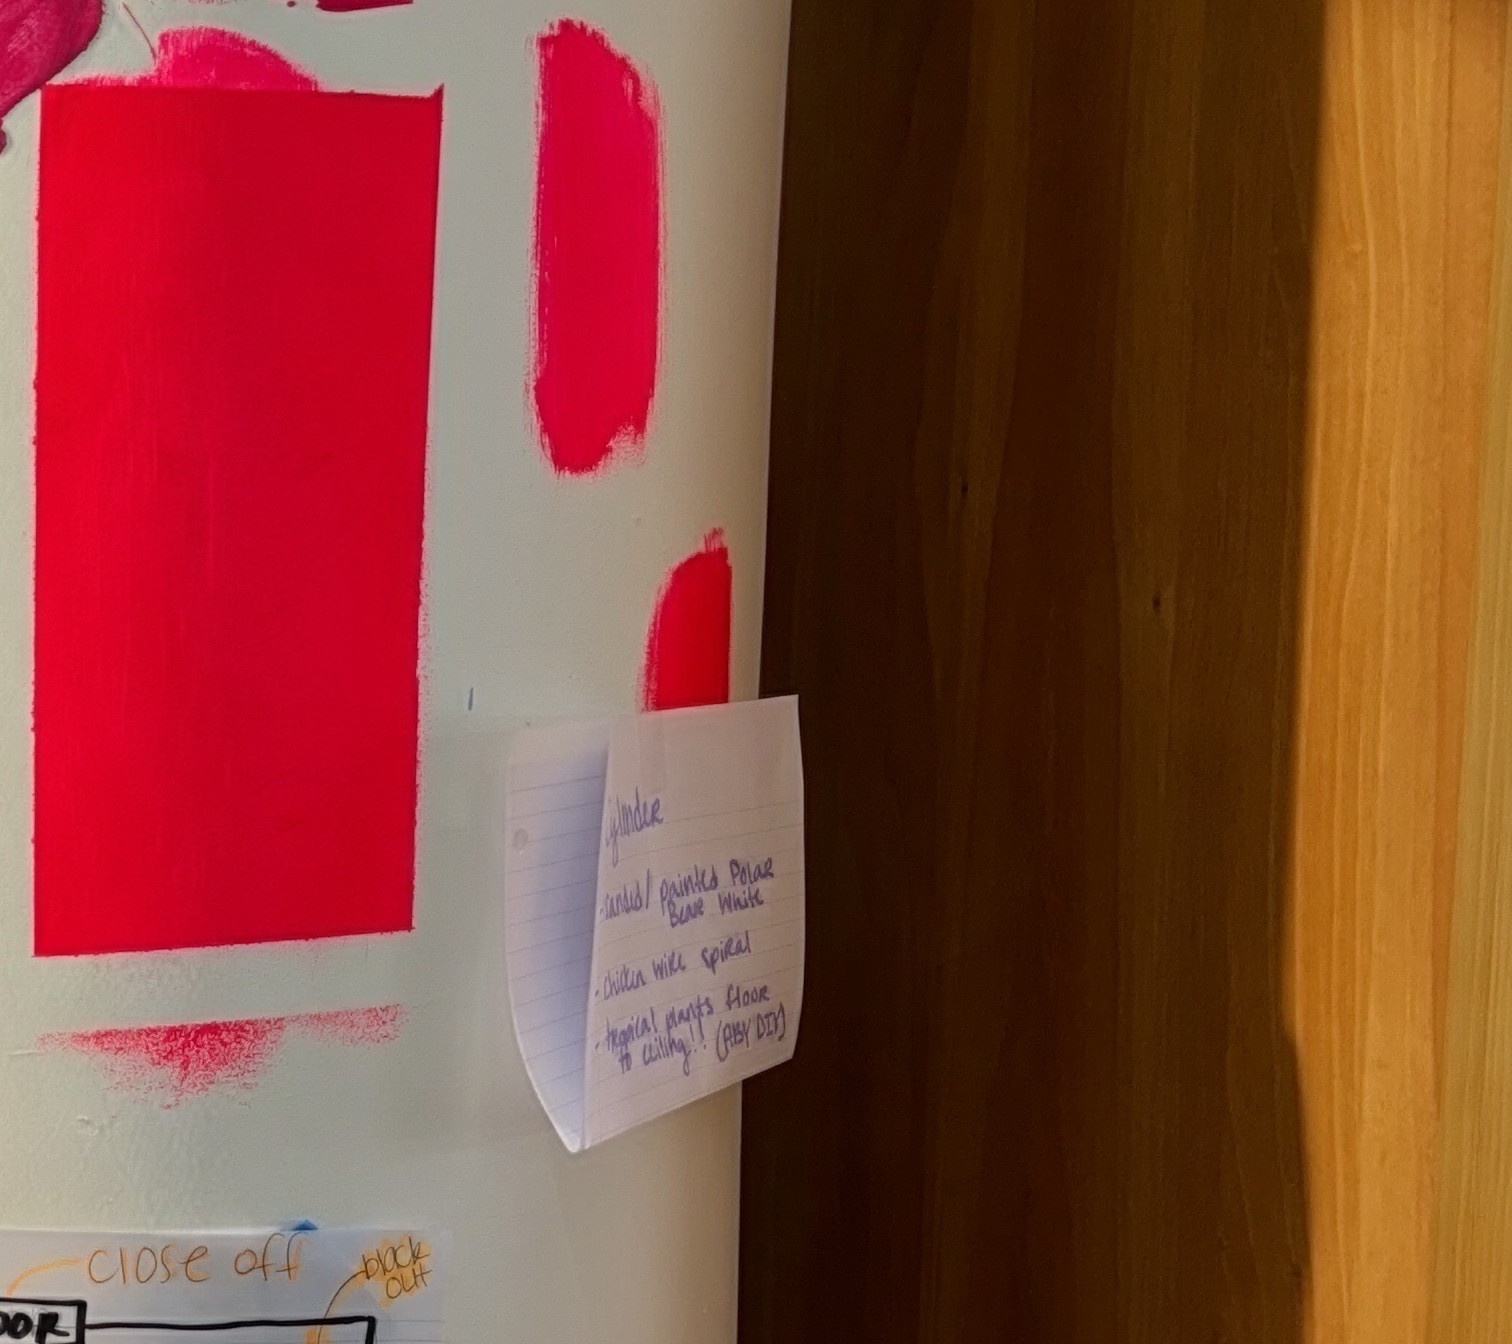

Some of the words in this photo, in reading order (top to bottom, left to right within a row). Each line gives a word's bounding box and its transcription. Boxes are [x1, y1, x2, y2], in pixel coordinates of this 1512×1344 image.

[660, 864, 719, 916] painted
[234, 1232, 308, 1284] off
[362, 1235, 431, 1280] black
[386, 1262, 432, 1299] out
